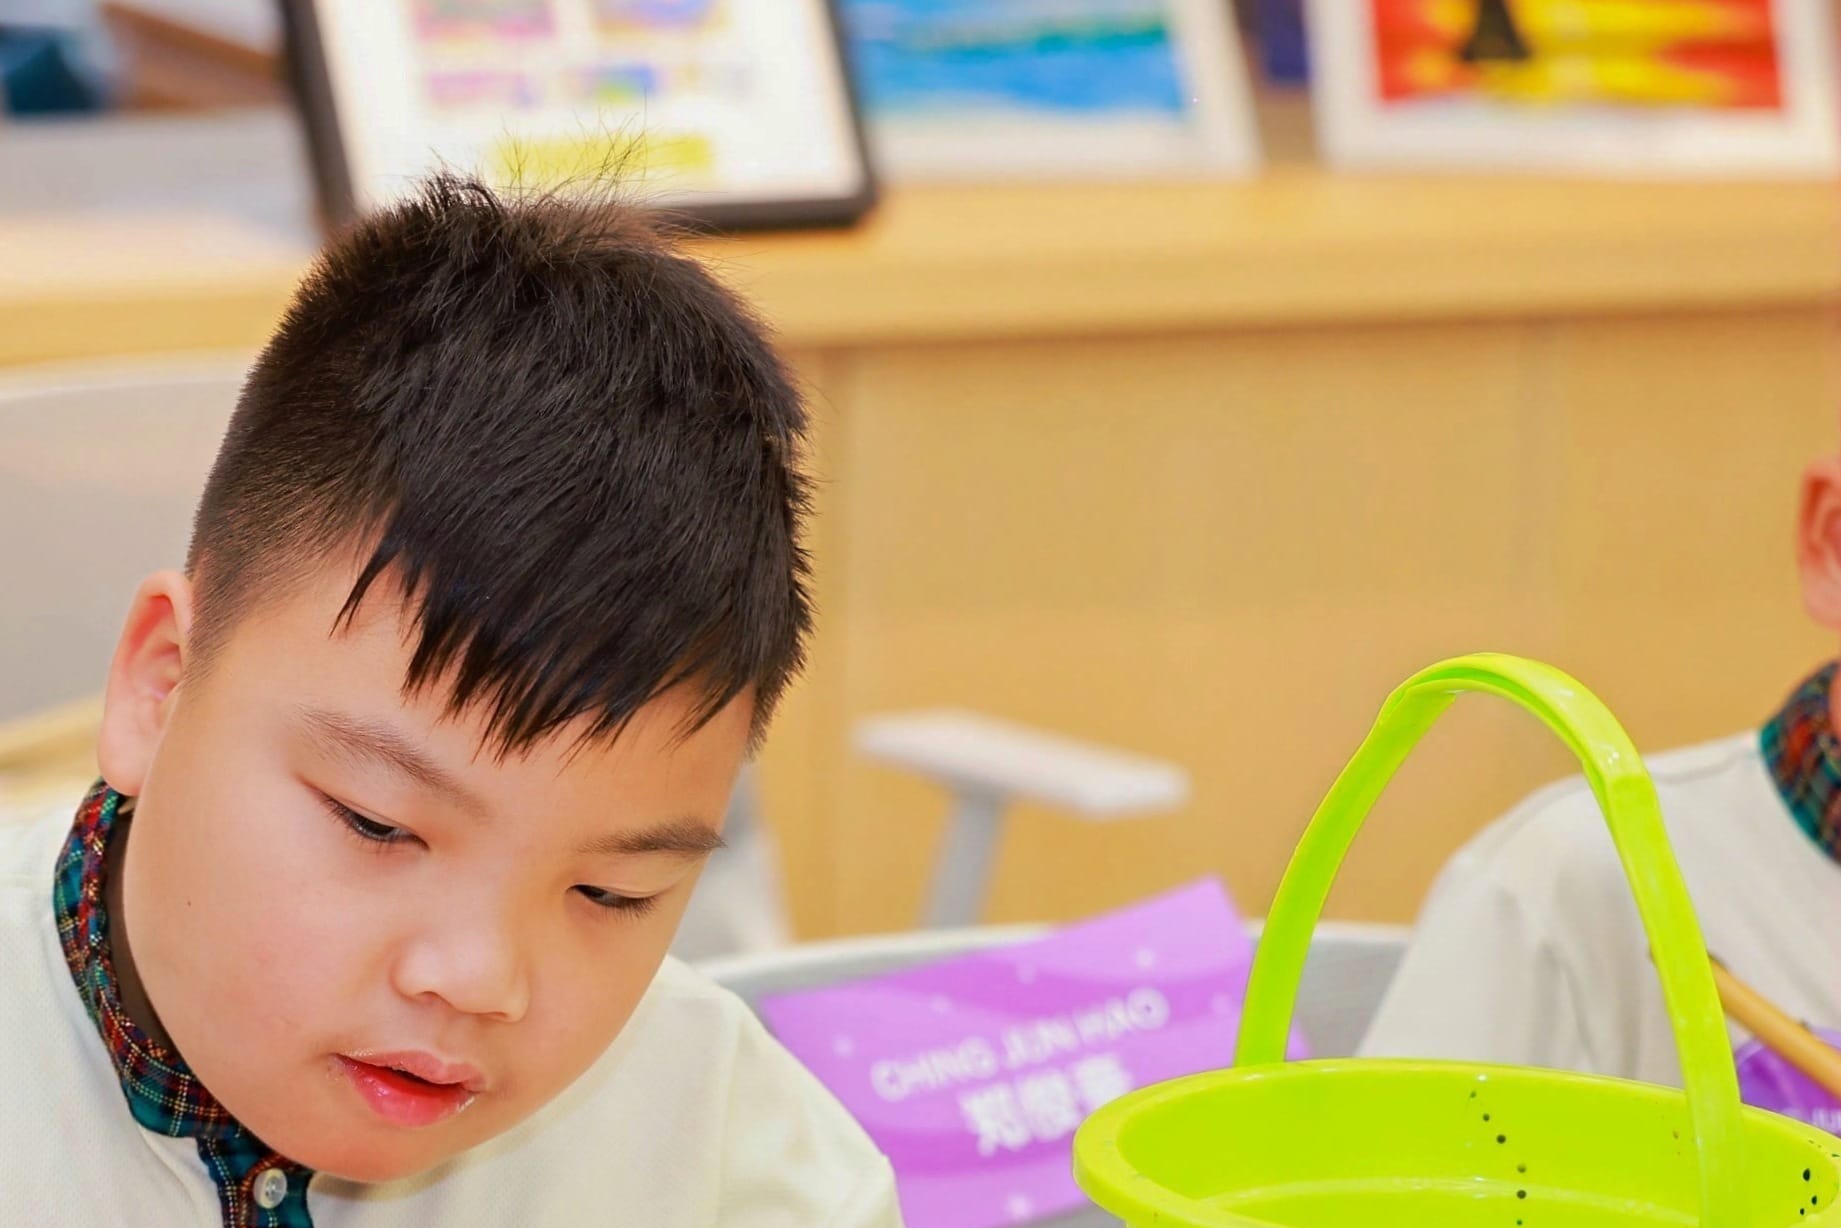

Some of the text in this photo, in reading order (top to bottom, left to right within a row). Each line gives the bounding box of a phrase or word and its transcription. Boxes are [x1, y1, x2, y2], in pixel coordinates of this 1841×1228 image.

[871, 988, 1170, 1101] CHING JUN HAO
